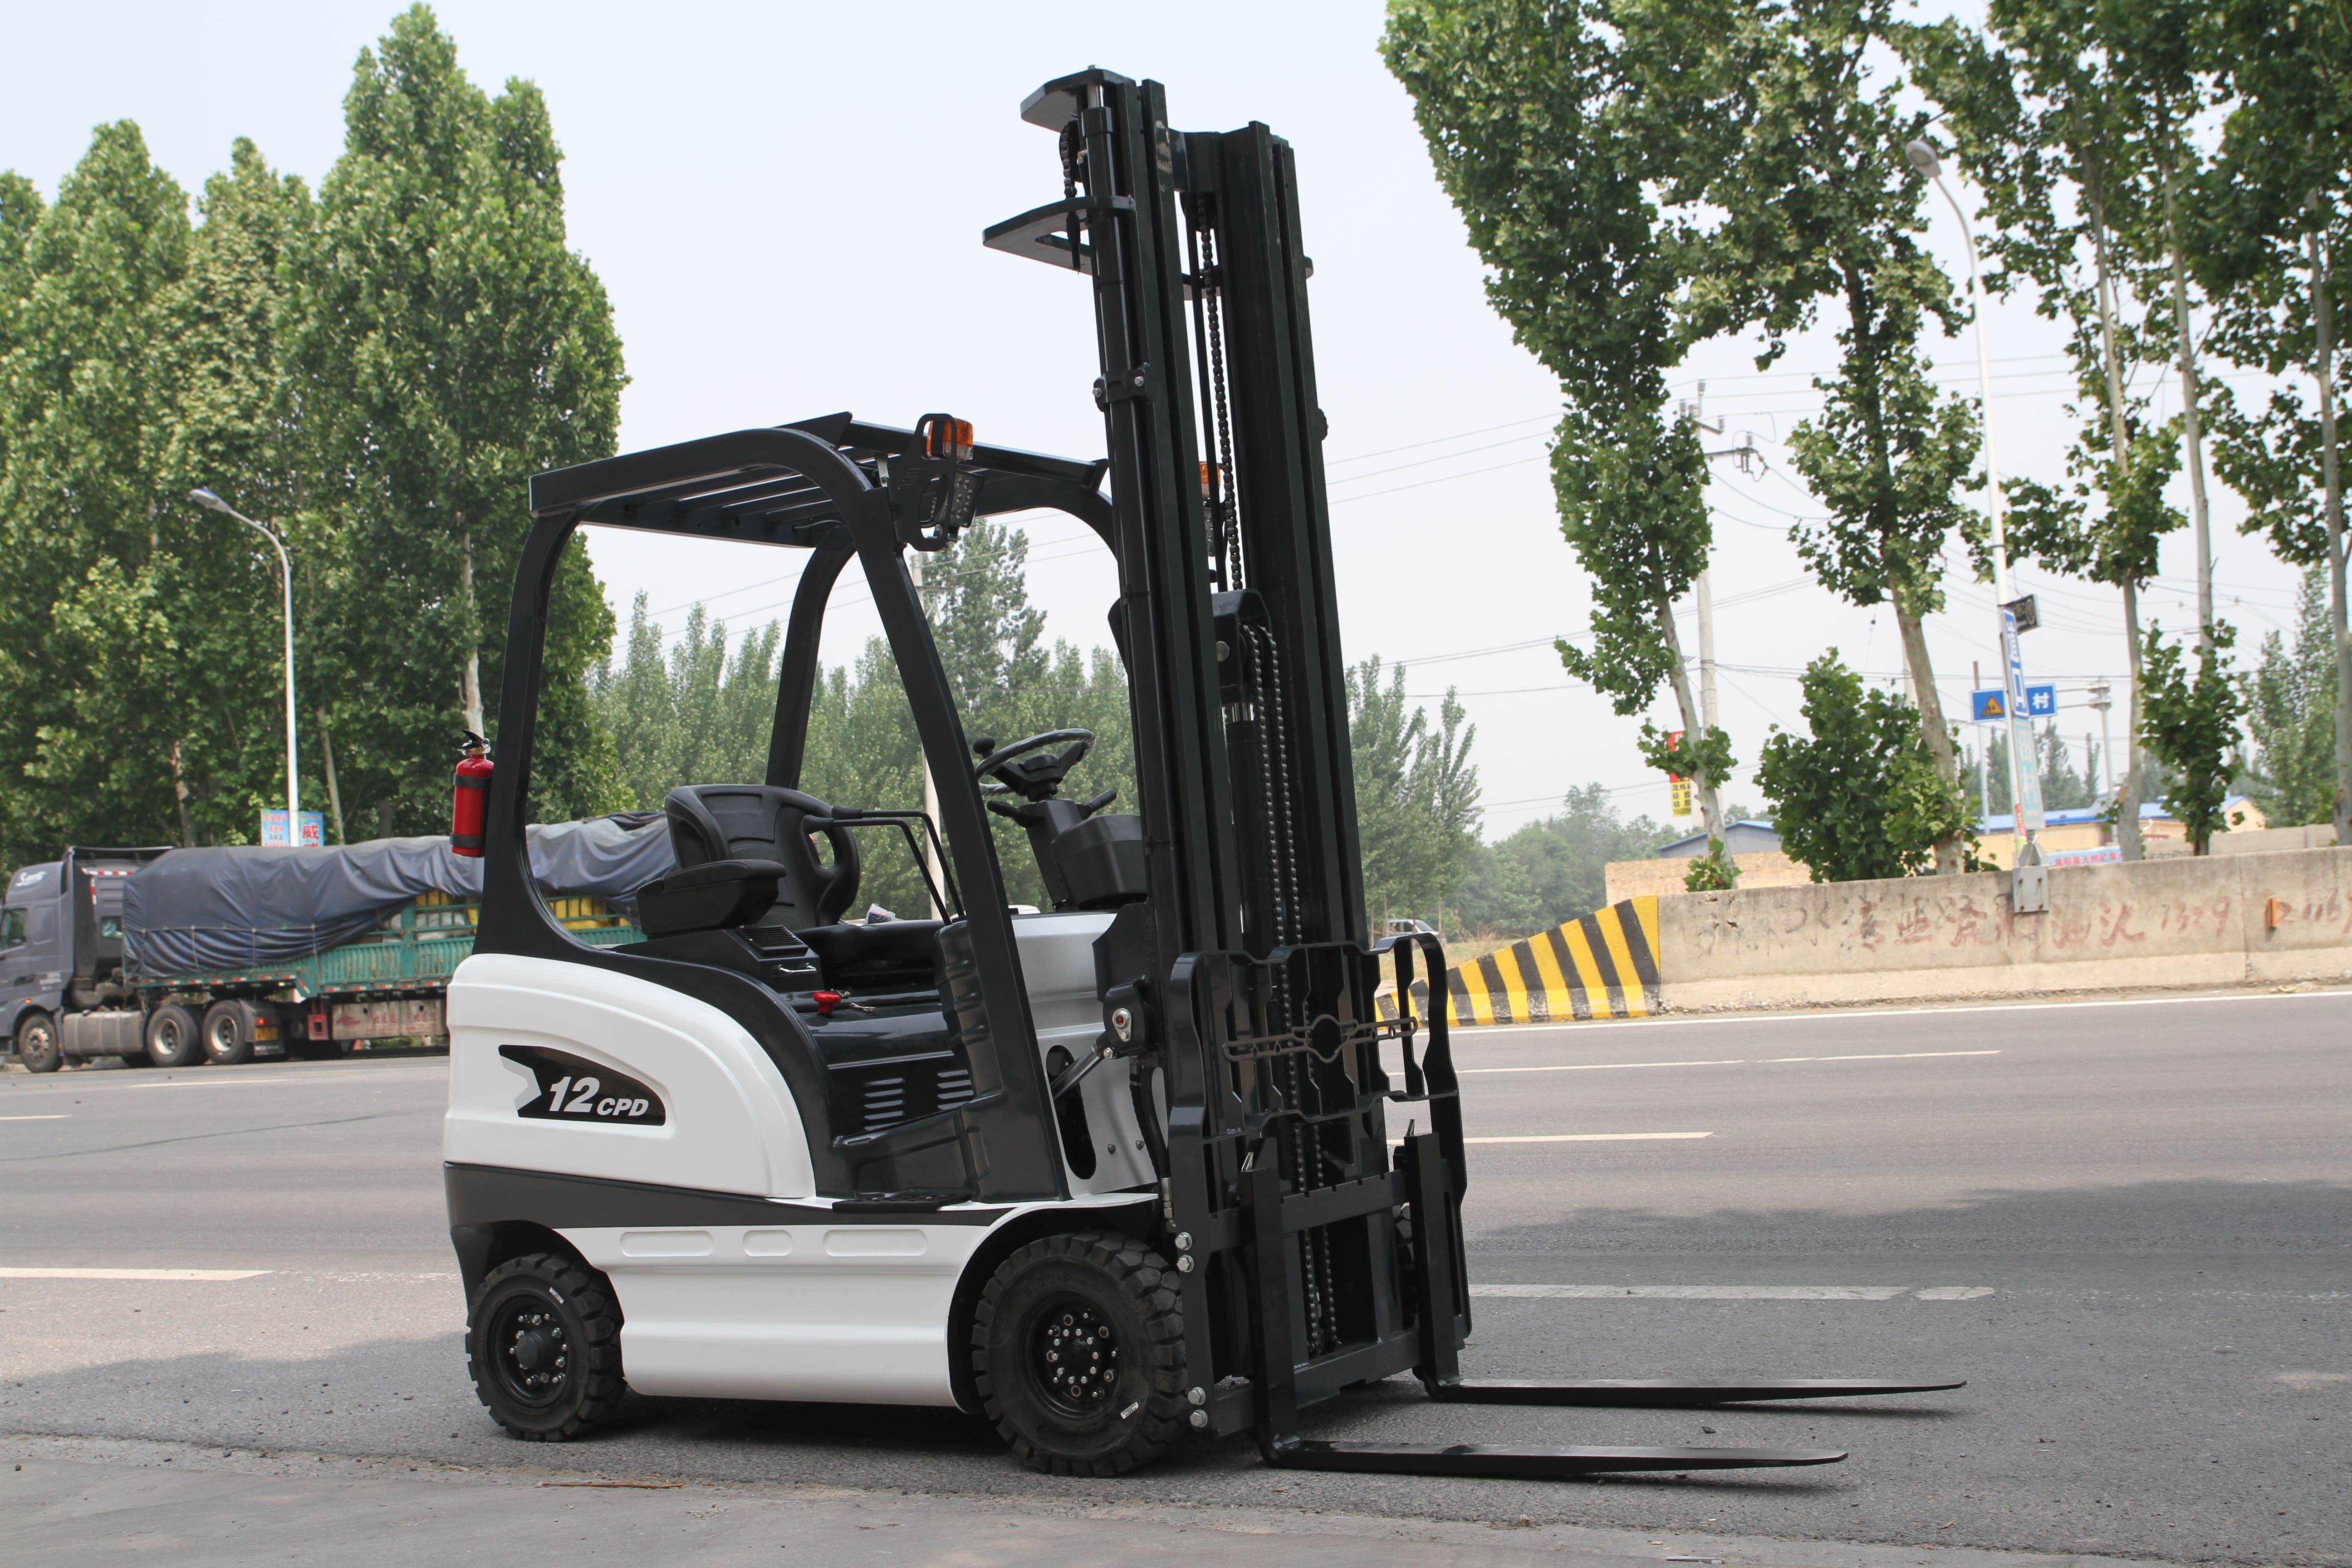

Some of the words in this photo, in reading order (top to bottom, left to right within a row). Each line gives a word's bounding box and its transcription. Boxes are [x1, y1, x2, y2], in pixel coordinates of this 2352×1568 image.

[2033, 691, 2050, 709] 村
[549, 1076, 601, 1112] 12
[597, 1098, 649, 1116] CPD
